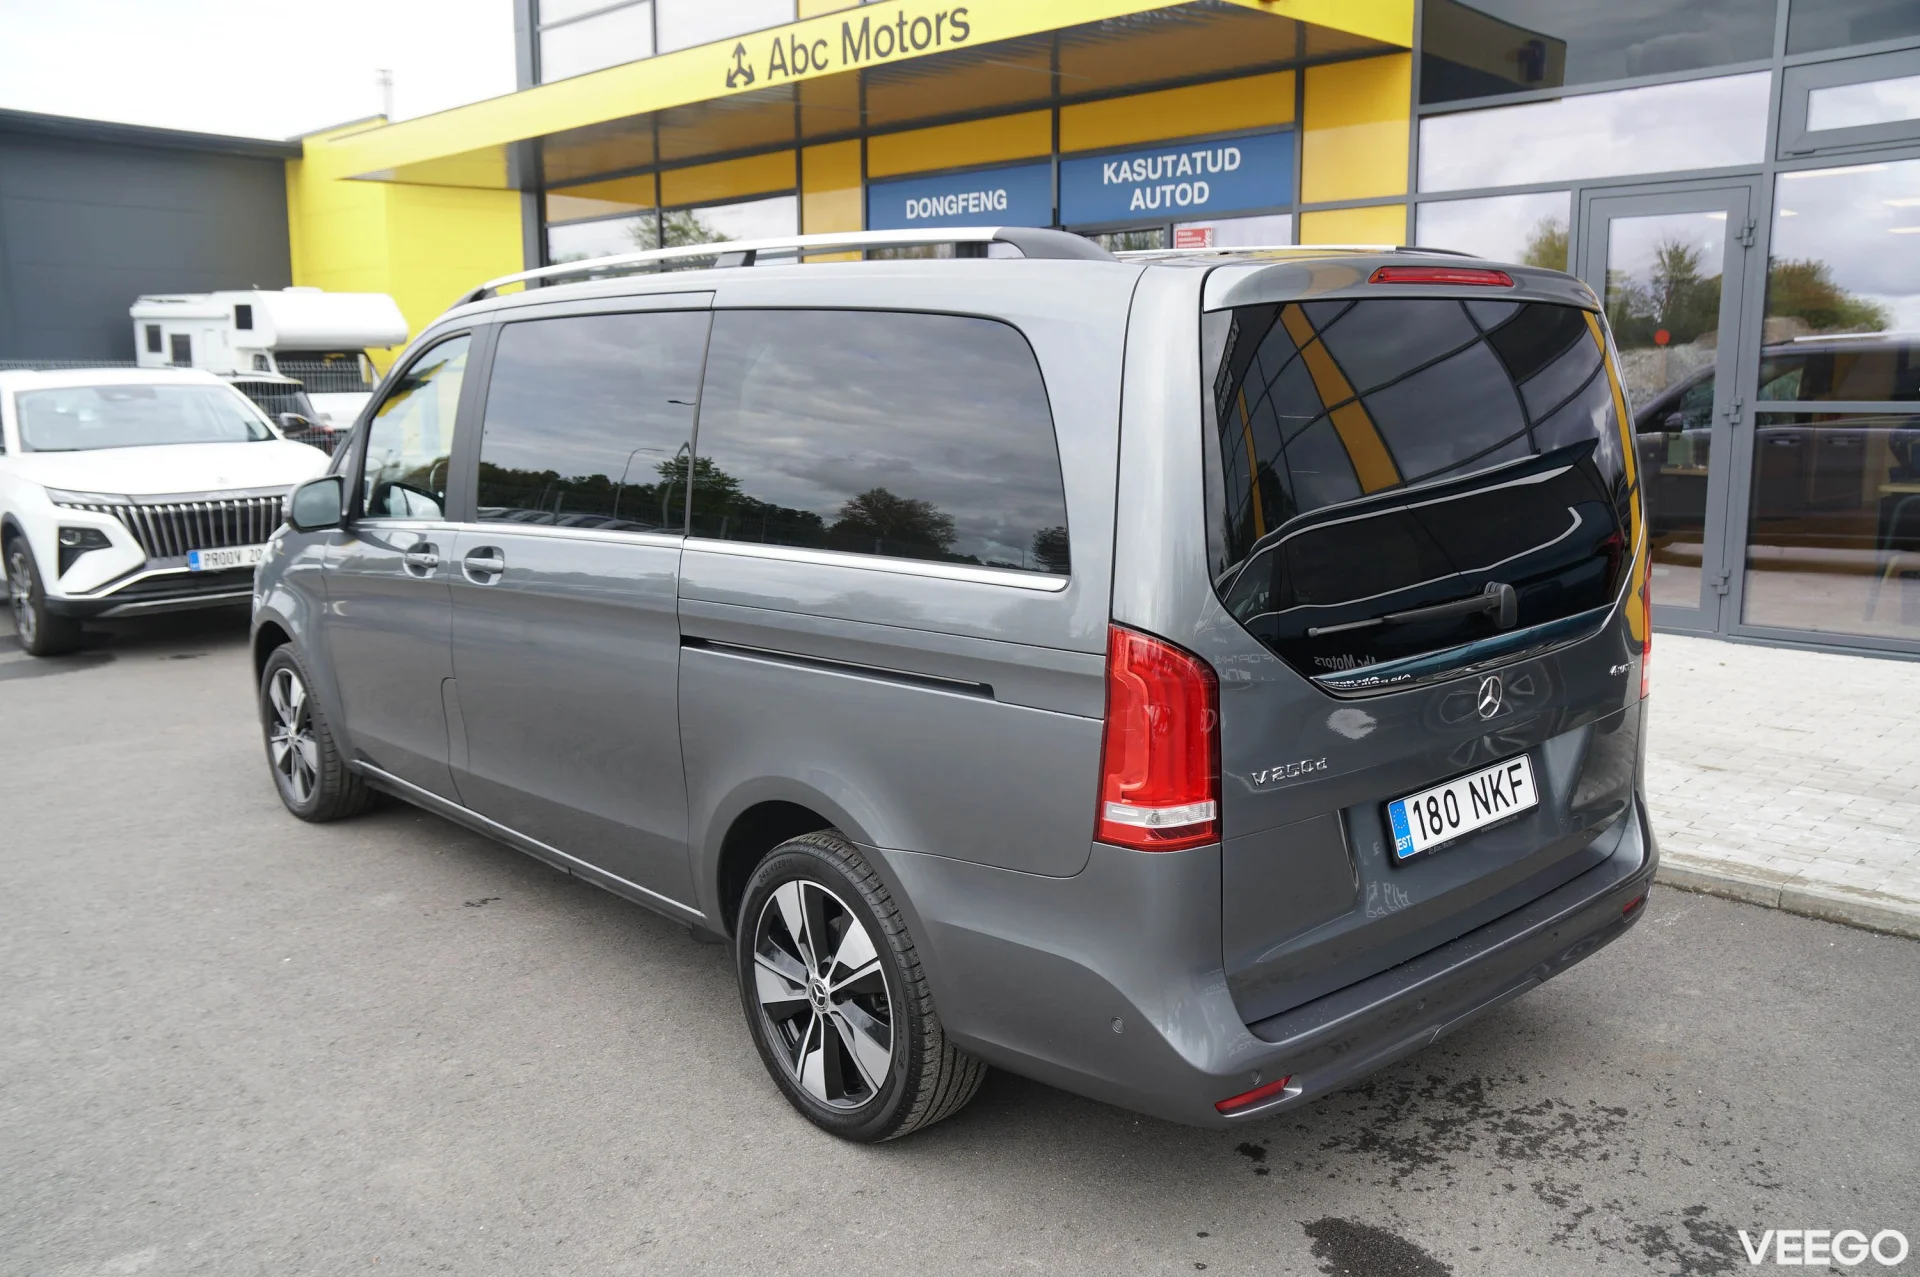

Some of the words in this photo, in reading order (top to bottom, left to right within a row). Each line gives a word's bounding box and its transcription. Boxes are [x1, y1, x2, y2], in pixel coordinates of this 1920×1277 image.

[768, 33, 829, 80] Abc
[841, 7, 970, 65] Motors
[1103, 147, 1241, 185] KASUTATUD
[906, 189, 1007, 219] DONGFENG
[1130, 181, 1210, 211] AUTOD
[1251, 770, 1269, 786] V
[1272, 757, 1328, 782] 250d
[1412, 788, 1460, 841] 180
[1468, 762, 1523, 820] NKF
[1396, 834, 1412, 850] EST
